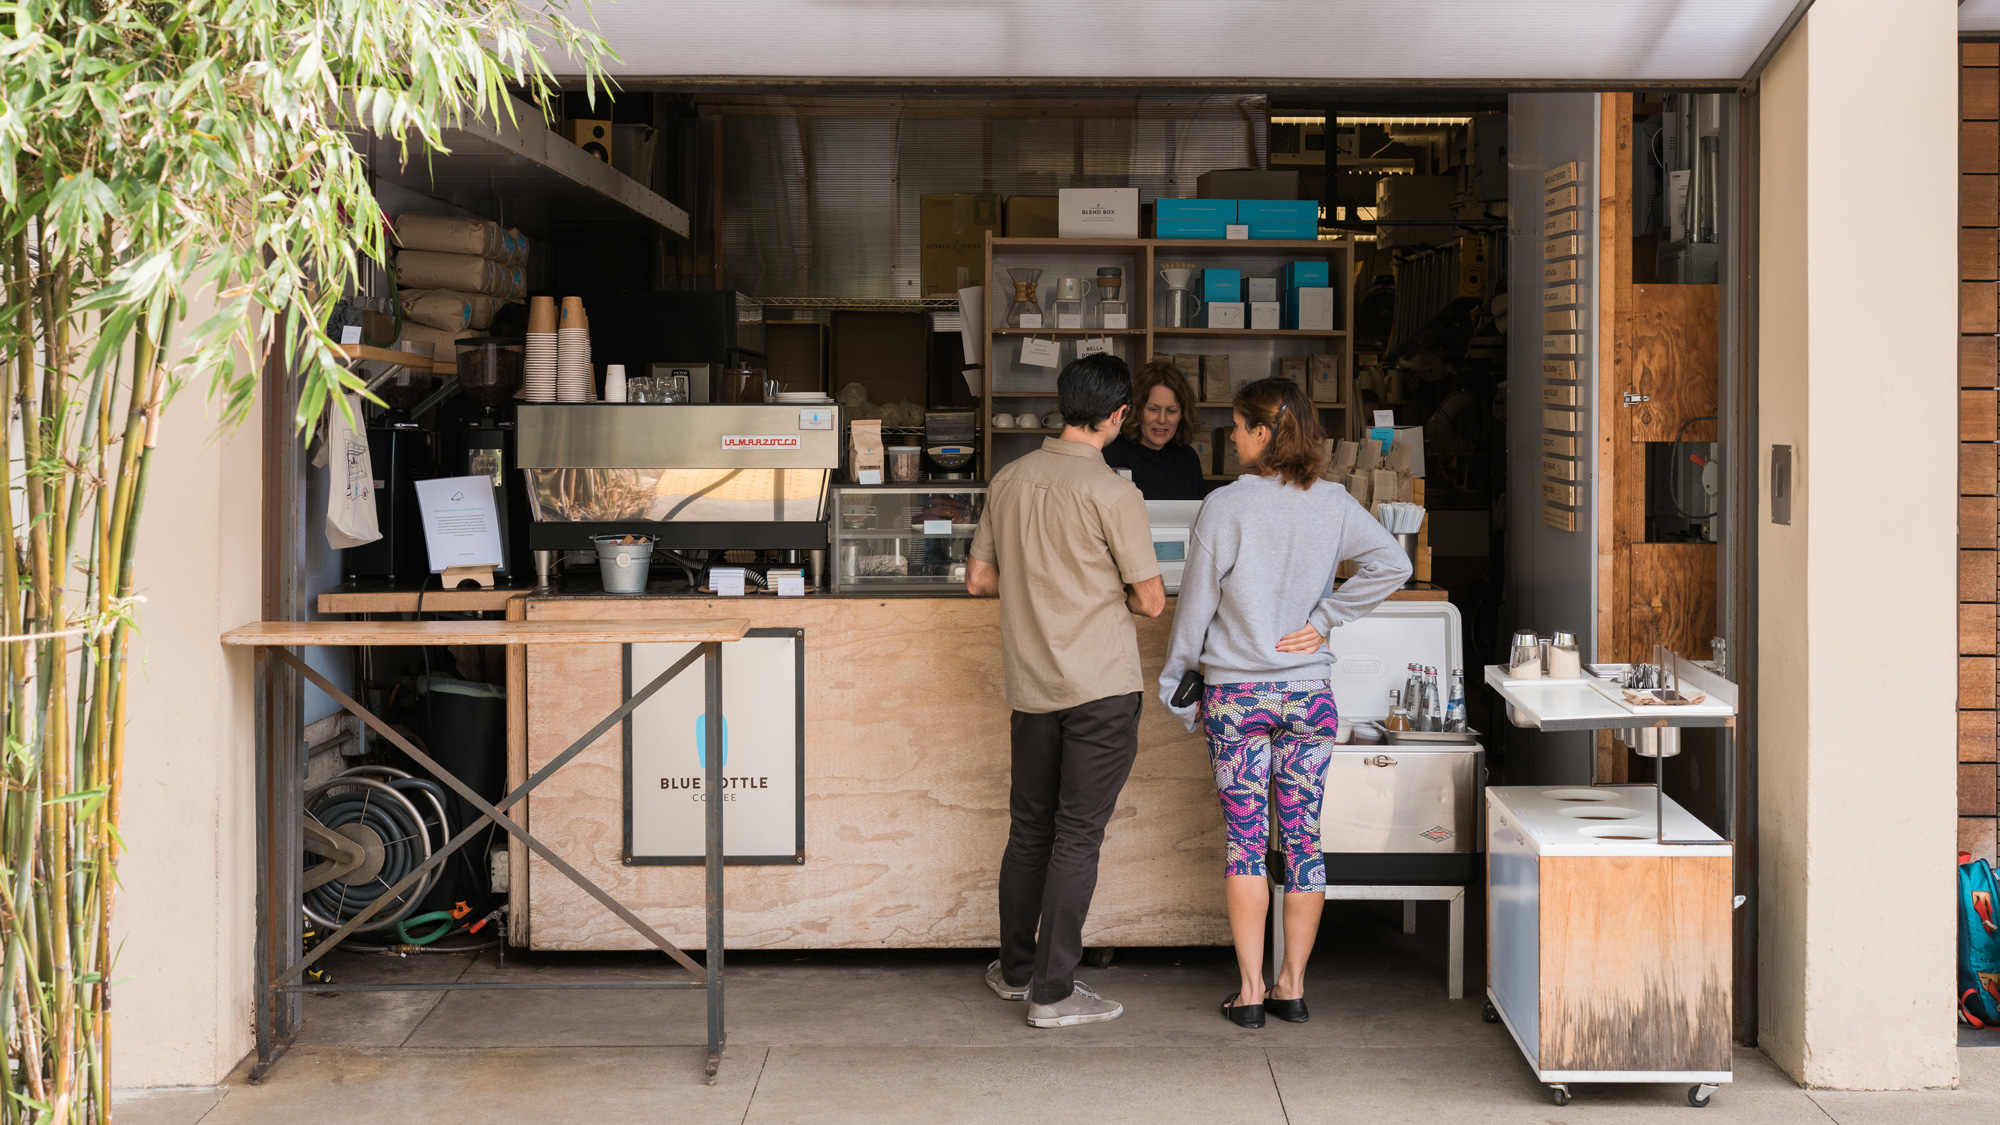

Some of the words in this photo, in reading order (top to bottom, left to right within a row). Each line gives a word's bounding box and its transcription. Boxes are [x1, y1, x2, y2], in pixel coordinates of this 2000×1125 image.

[660, 777, 701, 790] BLUE
[714, 776, 768, 789] OTTLE
[692, 793, 737, 802] COEE
